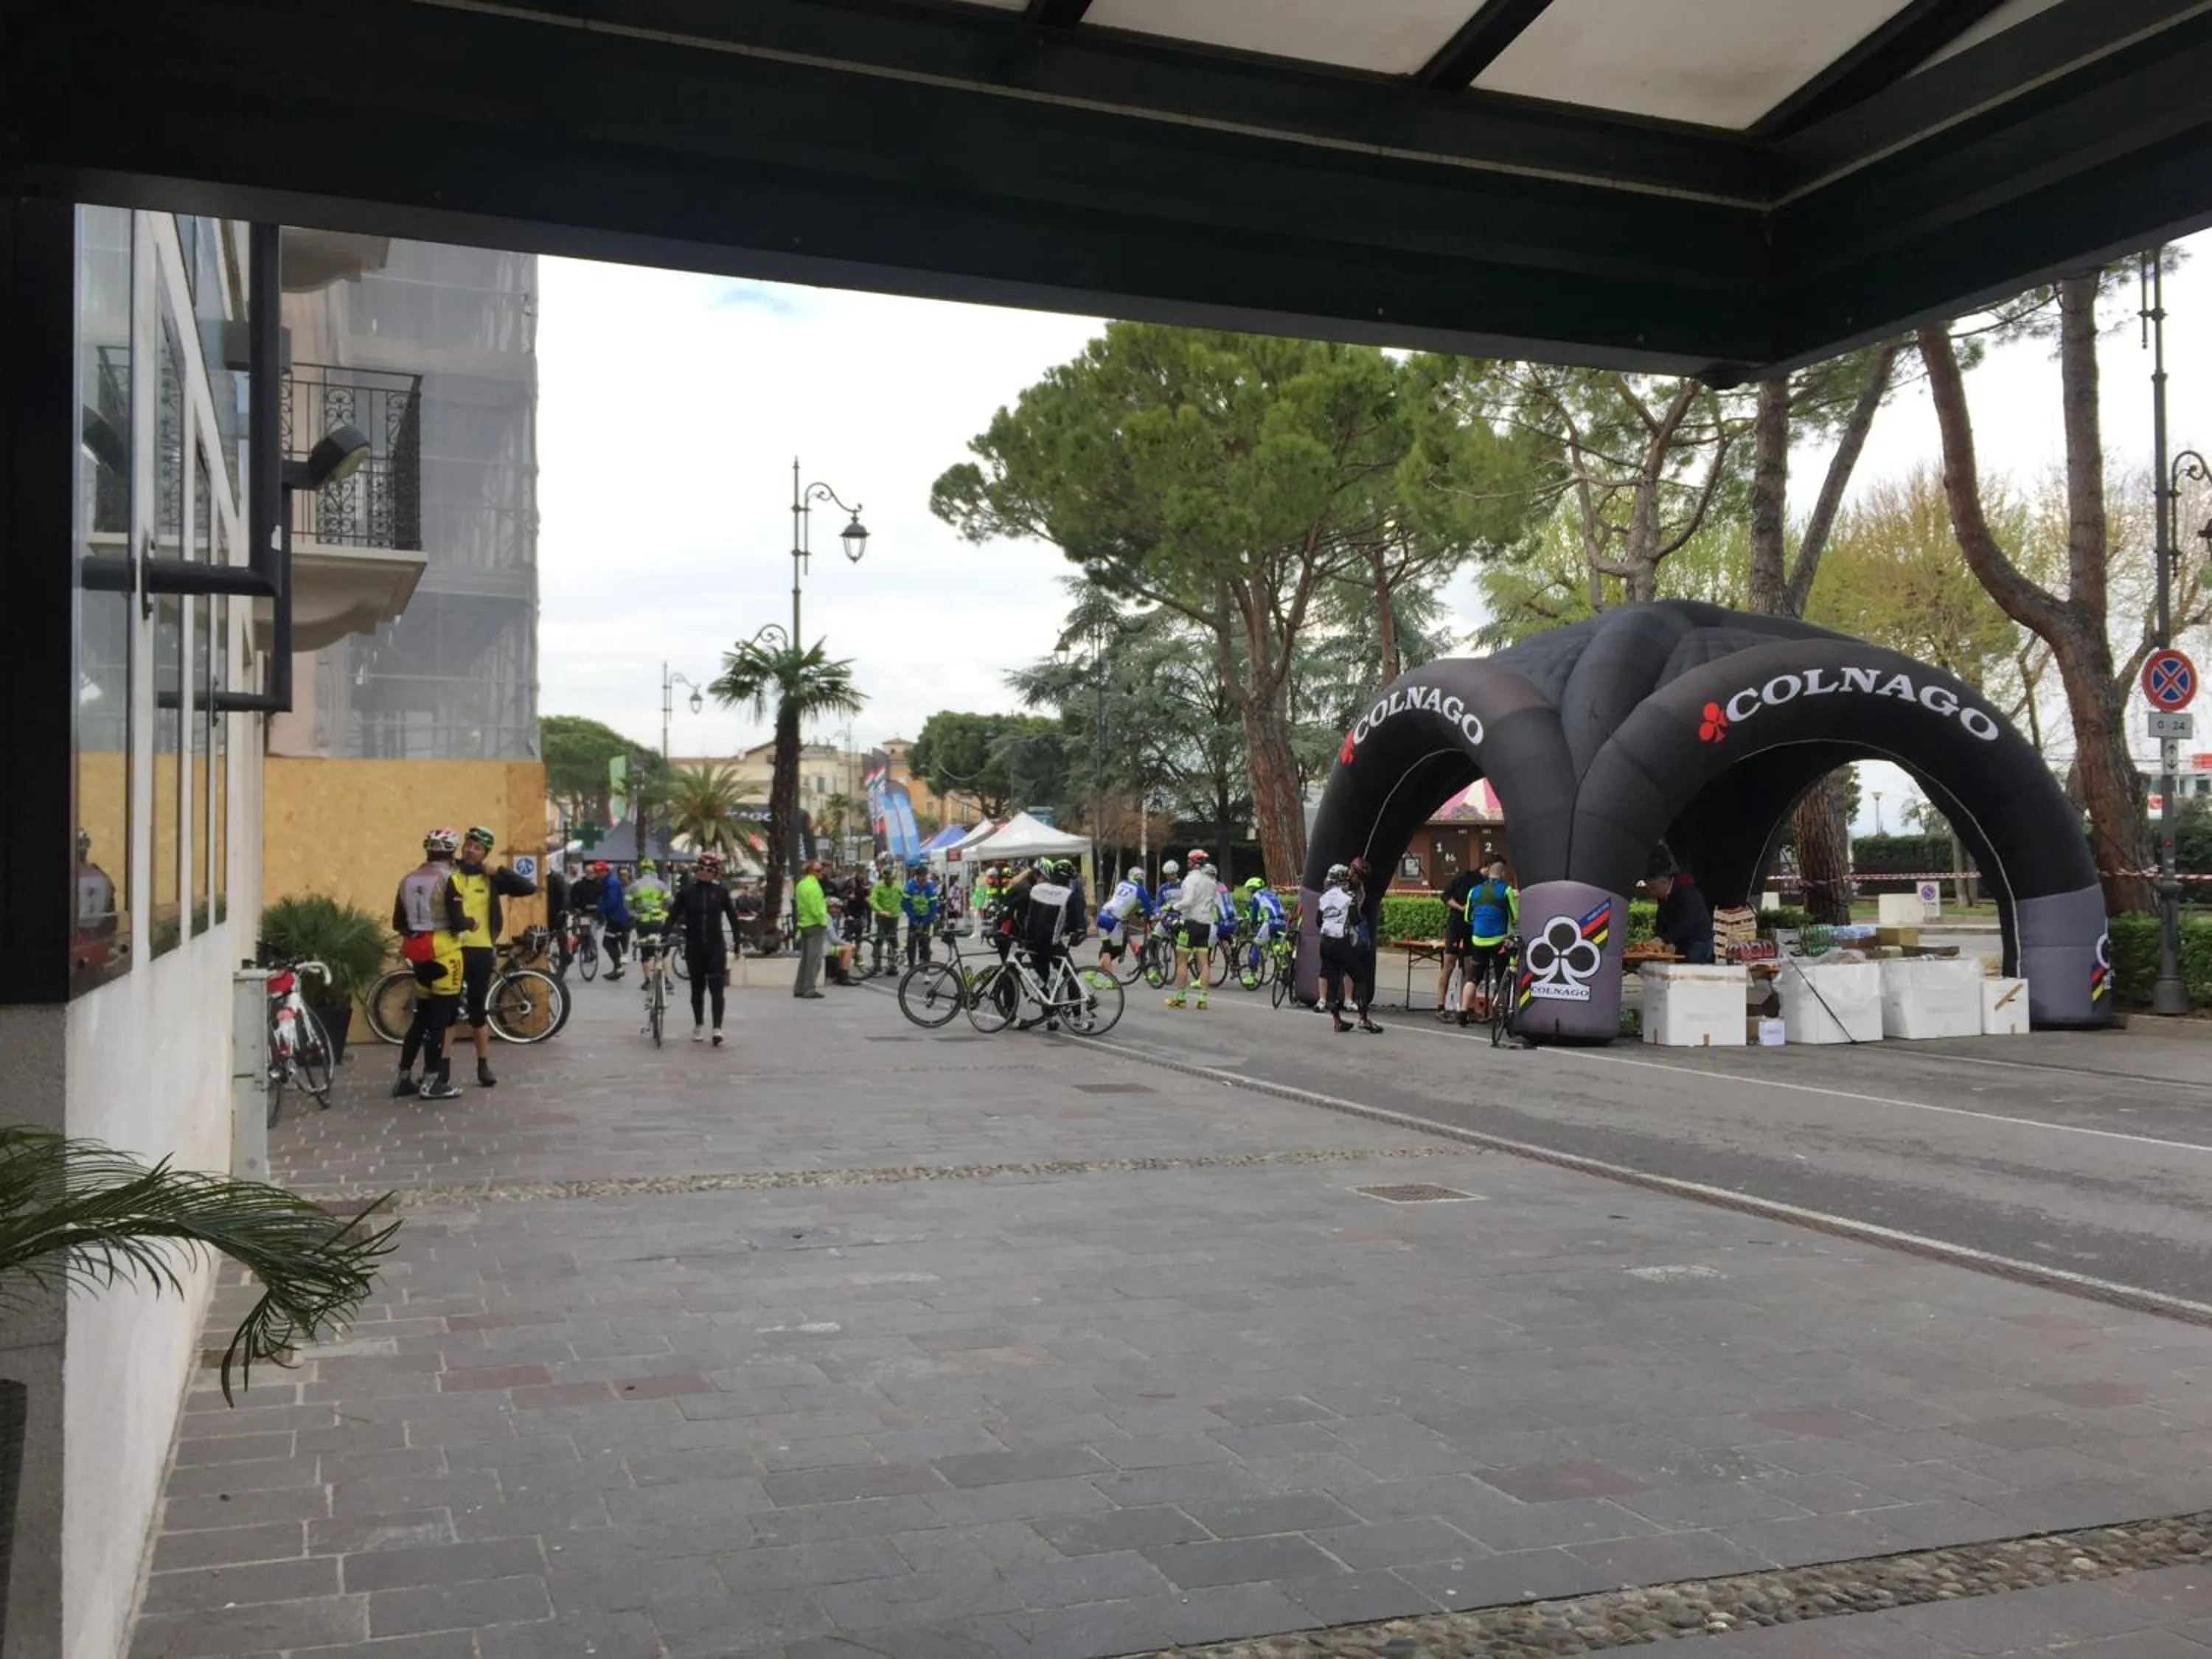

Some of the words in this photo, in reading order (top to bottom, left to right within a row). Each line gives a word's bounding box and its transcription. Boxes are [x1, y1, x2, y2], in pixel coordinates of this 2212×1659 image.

[1352, 686, 1484, 745] COLNAGO
[1725, 667, 2000, 742] COLNAGO
[1484, 842, 1492, 852] 2
[1531, 985, 1590, 996] COLNAGO
